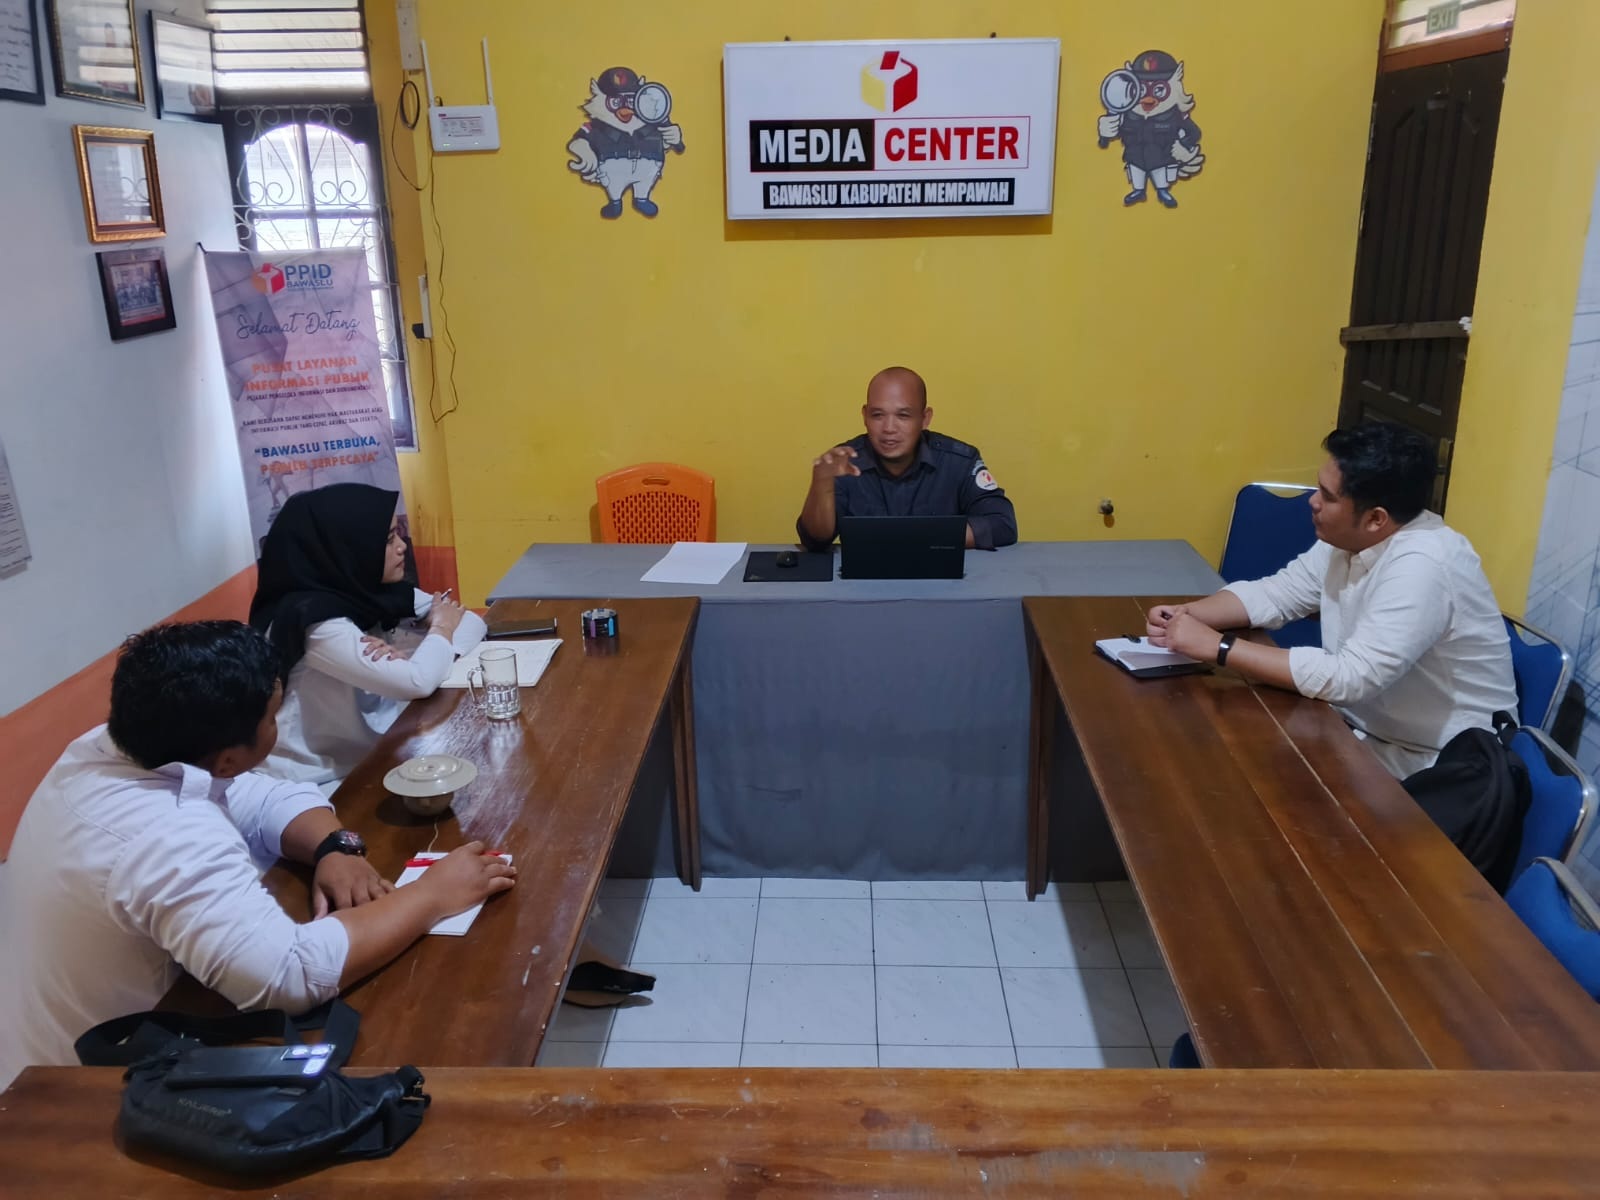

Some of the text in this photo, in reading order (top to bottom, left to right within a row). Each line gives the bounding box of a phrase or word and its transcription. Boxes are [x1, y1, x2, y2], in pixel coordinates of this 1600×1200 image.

[1429, 7, 1457, 31] EXIT
[759, 126, 1019, 163] MEDIA CENTER
[768, 181, 1009, 206] BAWASLU KABUPATEN MEMPAWAH
[285, 264, 332, 280] PPID
[286, 279, 333, 288] BAWASLU
[236, 310, 360, 341] Selamat Datang
[252, 356, 357, 374] PUSAT LAYANAN
[243, 371, 369, 391] INFORMASI PUBLIK
[323, 436, 381, 451] TERBUKA,
